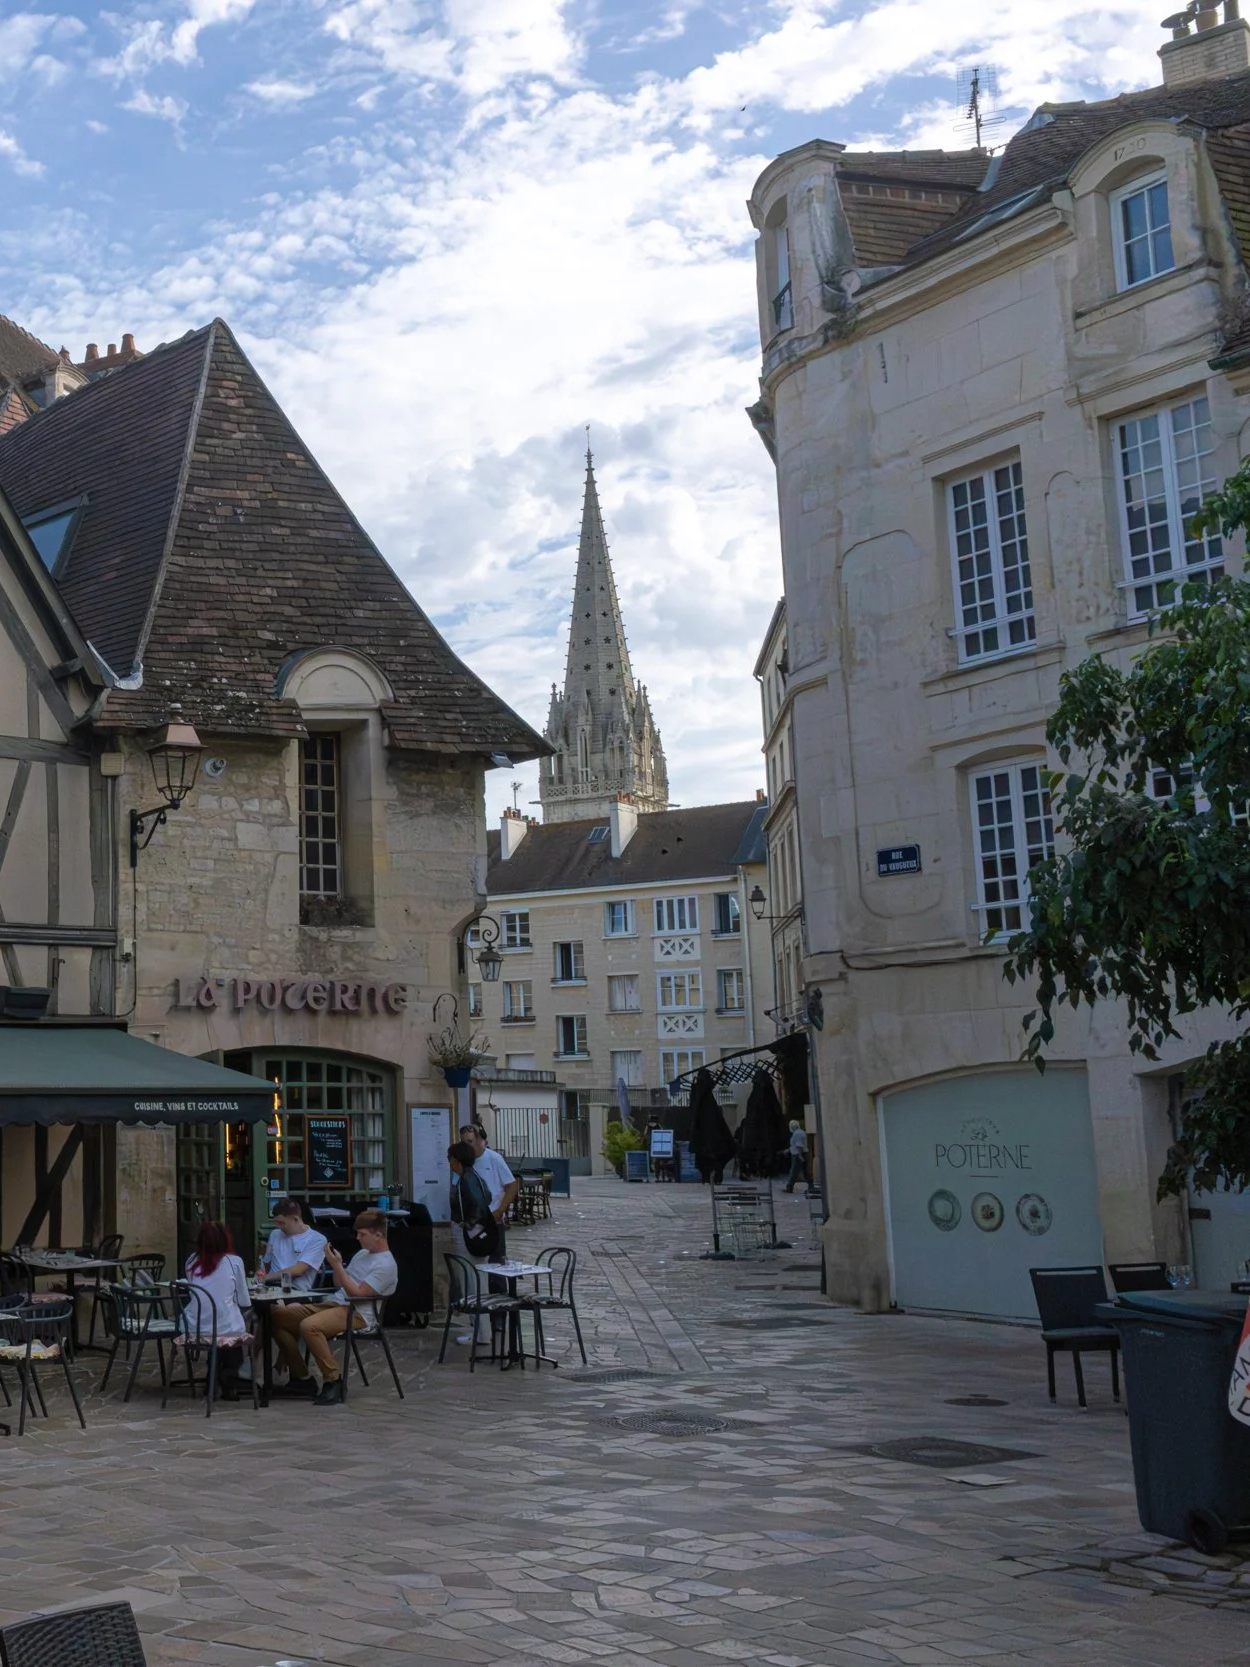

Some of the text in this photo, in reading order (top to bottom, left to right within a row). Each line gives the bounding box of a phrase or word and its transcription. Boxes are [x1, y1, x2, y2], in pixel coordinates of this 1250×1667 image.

[892, 851, 902, 859] RUE
[880, 864, 887, 872] DU
[134, 1102, 239, 1111] CUISINE, VINS ET COCKTAILS
[935, 1143, 1033, 1170] POTERNE
